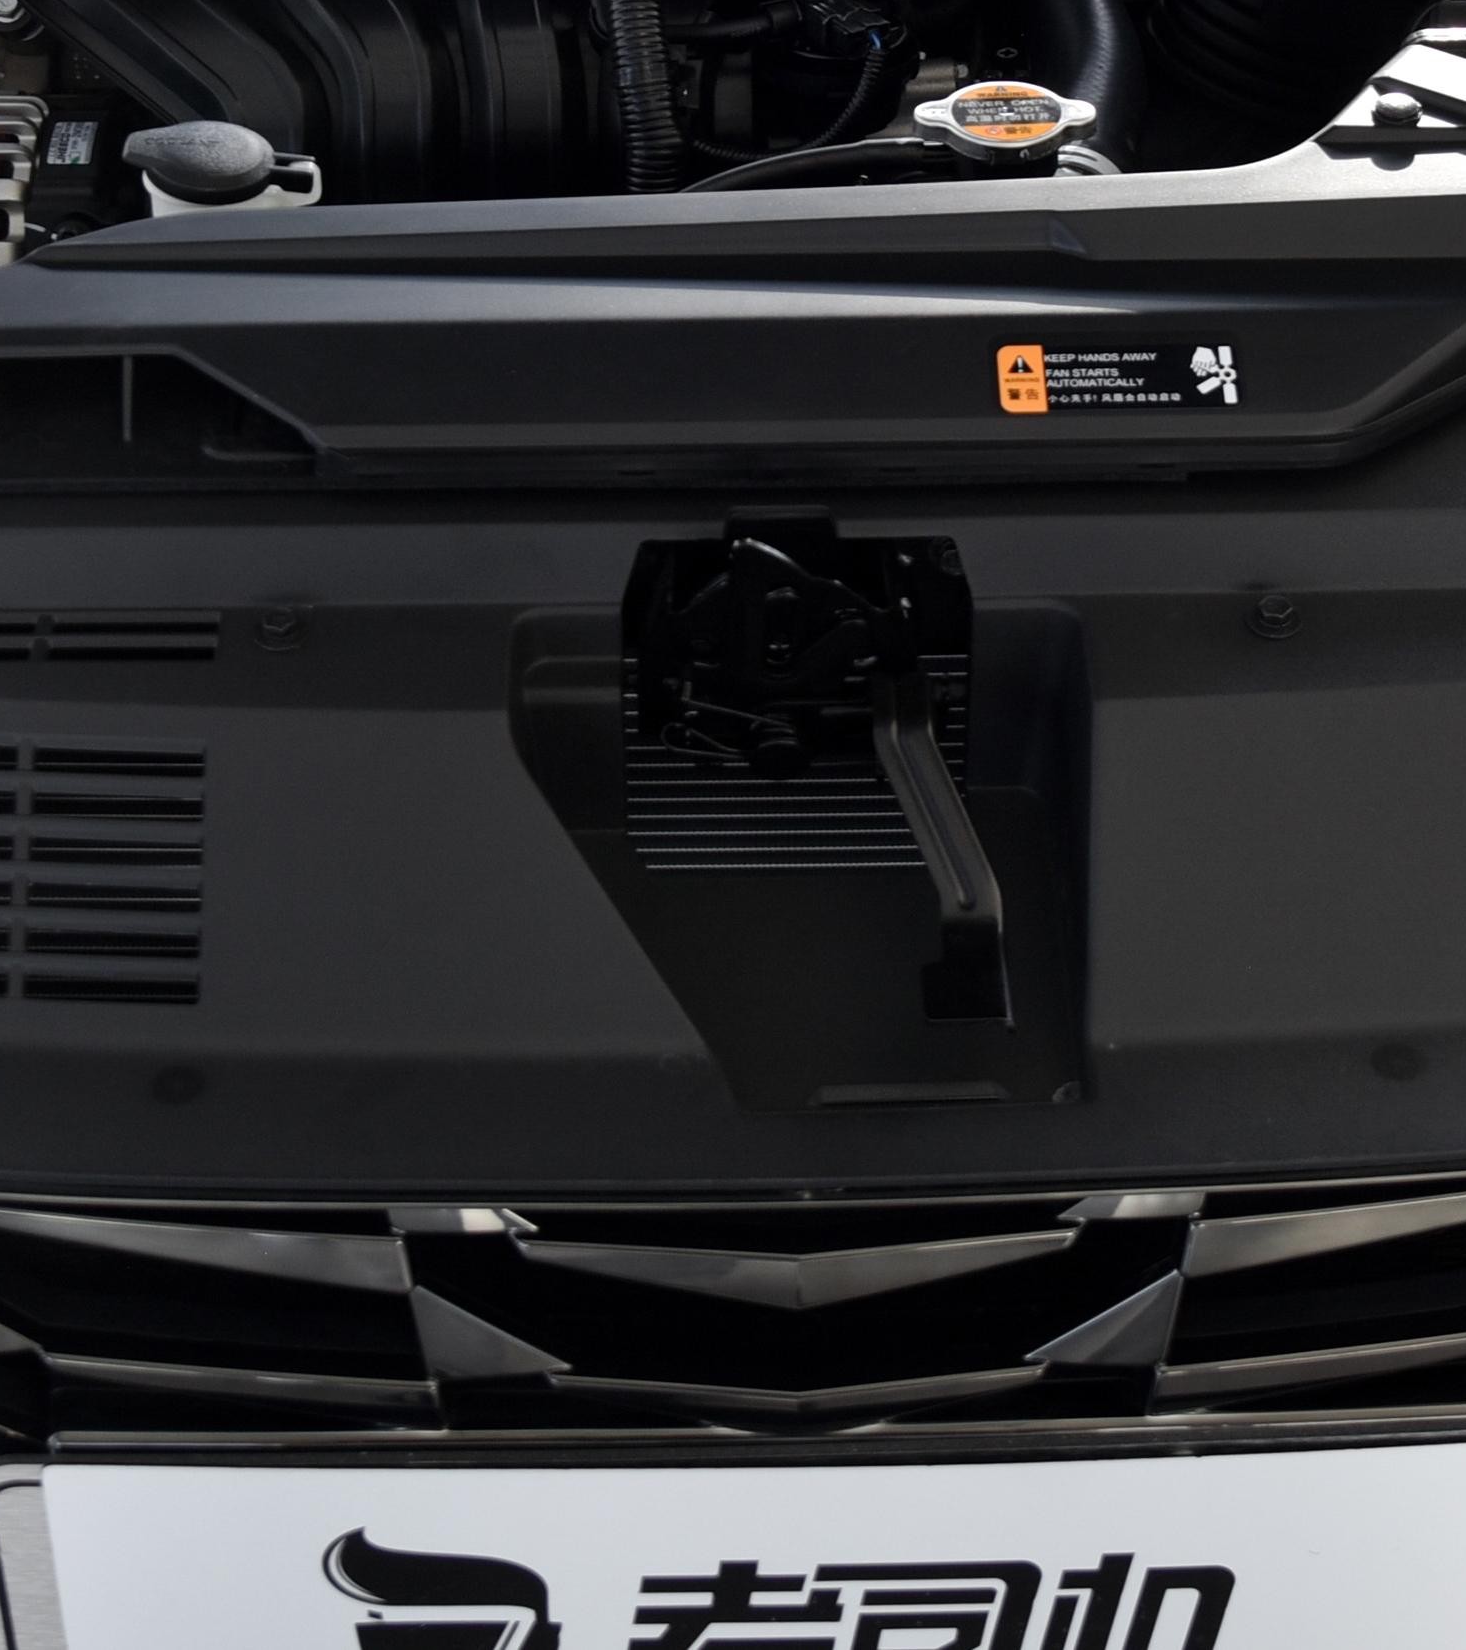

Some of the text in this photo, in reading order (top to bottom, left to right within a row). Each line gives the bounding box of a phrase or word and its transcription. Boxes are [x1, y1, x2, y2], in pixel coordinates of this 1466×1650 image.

[958, 100, 1005, 108] NEVER
[1043, 352, 1157, 363] KEEP HANDS AWAY
[1045, 368, 1119, 378] FAN STARTS
[1046, 377, 1145, 388] AUTOMATICALLY
